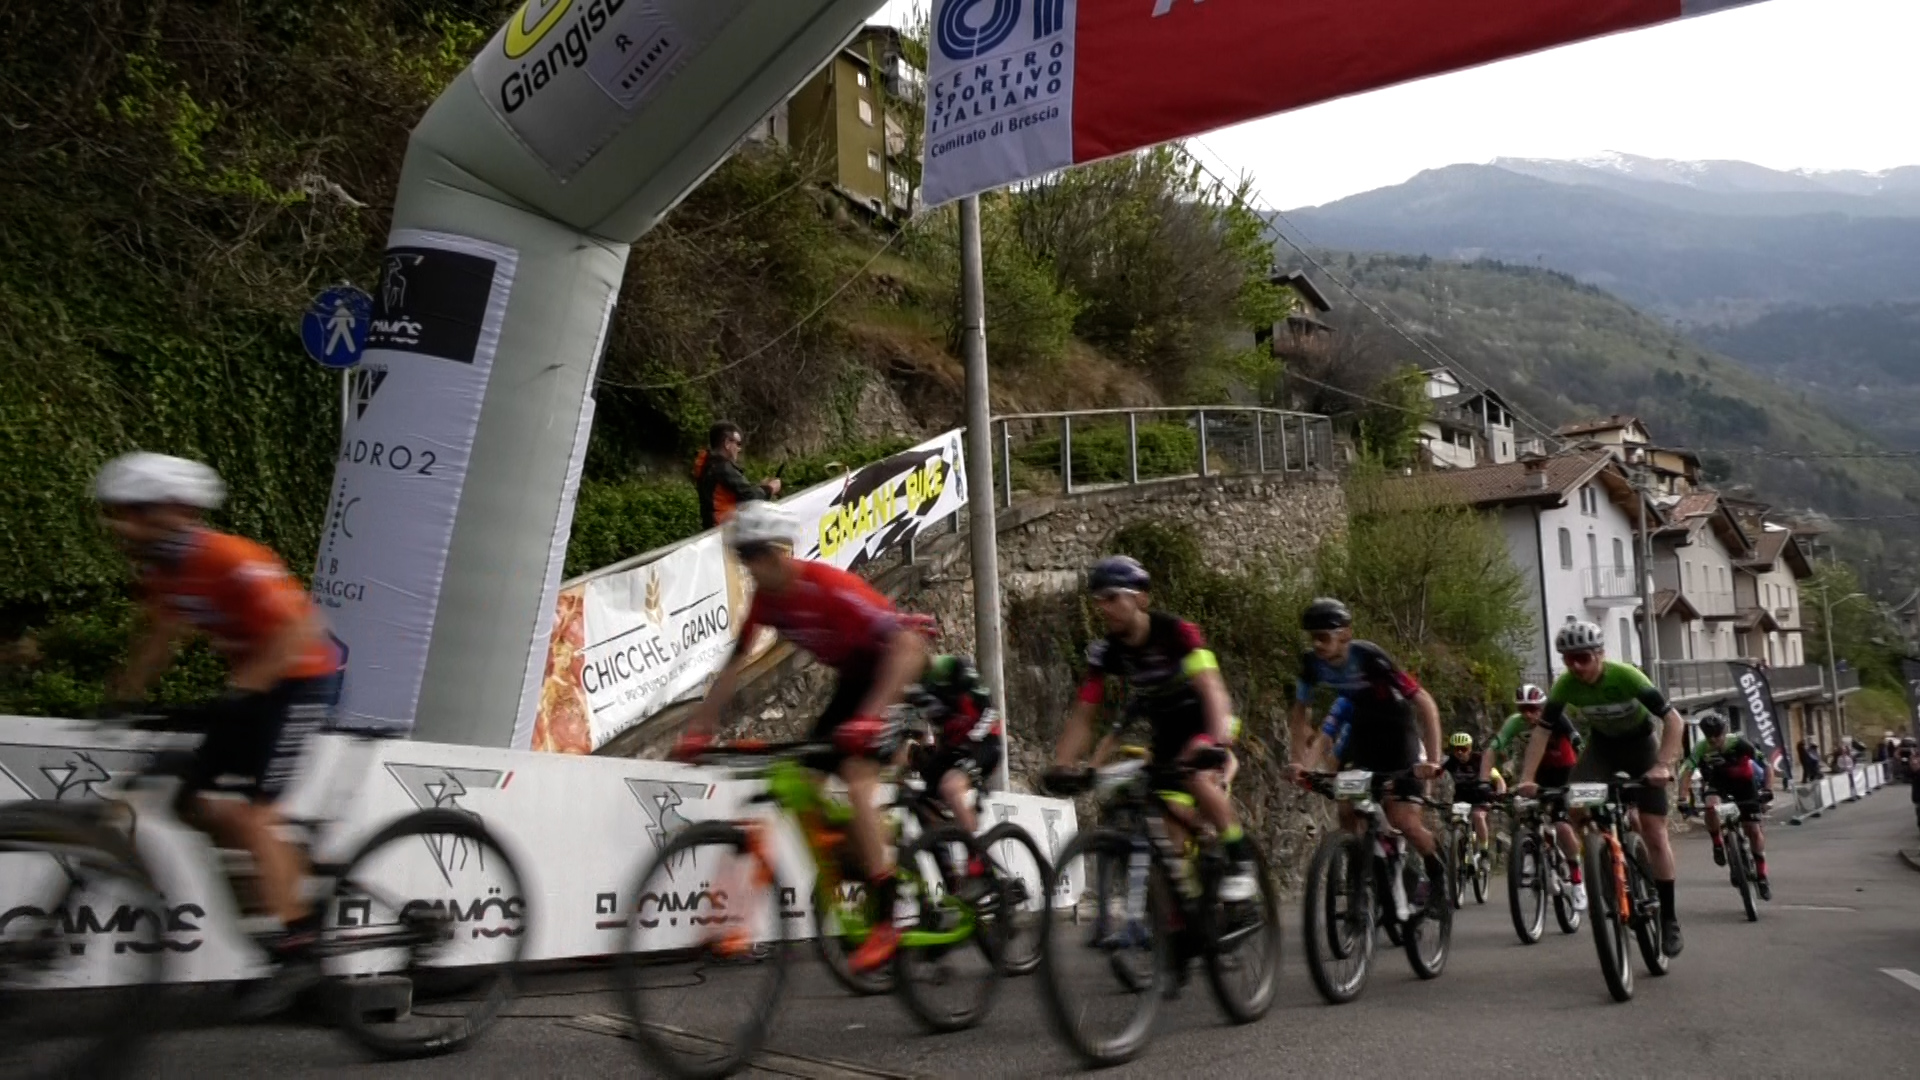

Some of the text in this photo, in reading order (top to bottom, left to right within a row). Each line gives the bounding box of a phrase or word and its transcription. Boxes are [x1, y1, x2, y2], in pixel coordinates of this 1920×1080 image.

[621, 37, 670, 90] RESERVE
[934, 60, 1062, 116] SPORTIVO
[935, 41, 1064, 98] CENTRO
[931, 78, 1061, 134] ITALIANO
[931, 106, 1059, 158] Comitato di Brescia
[905, 456, 943, 512] BIKE
[582, 635, 670, 694] CHICCHE
[682, 605, 729, 650] GRANO
